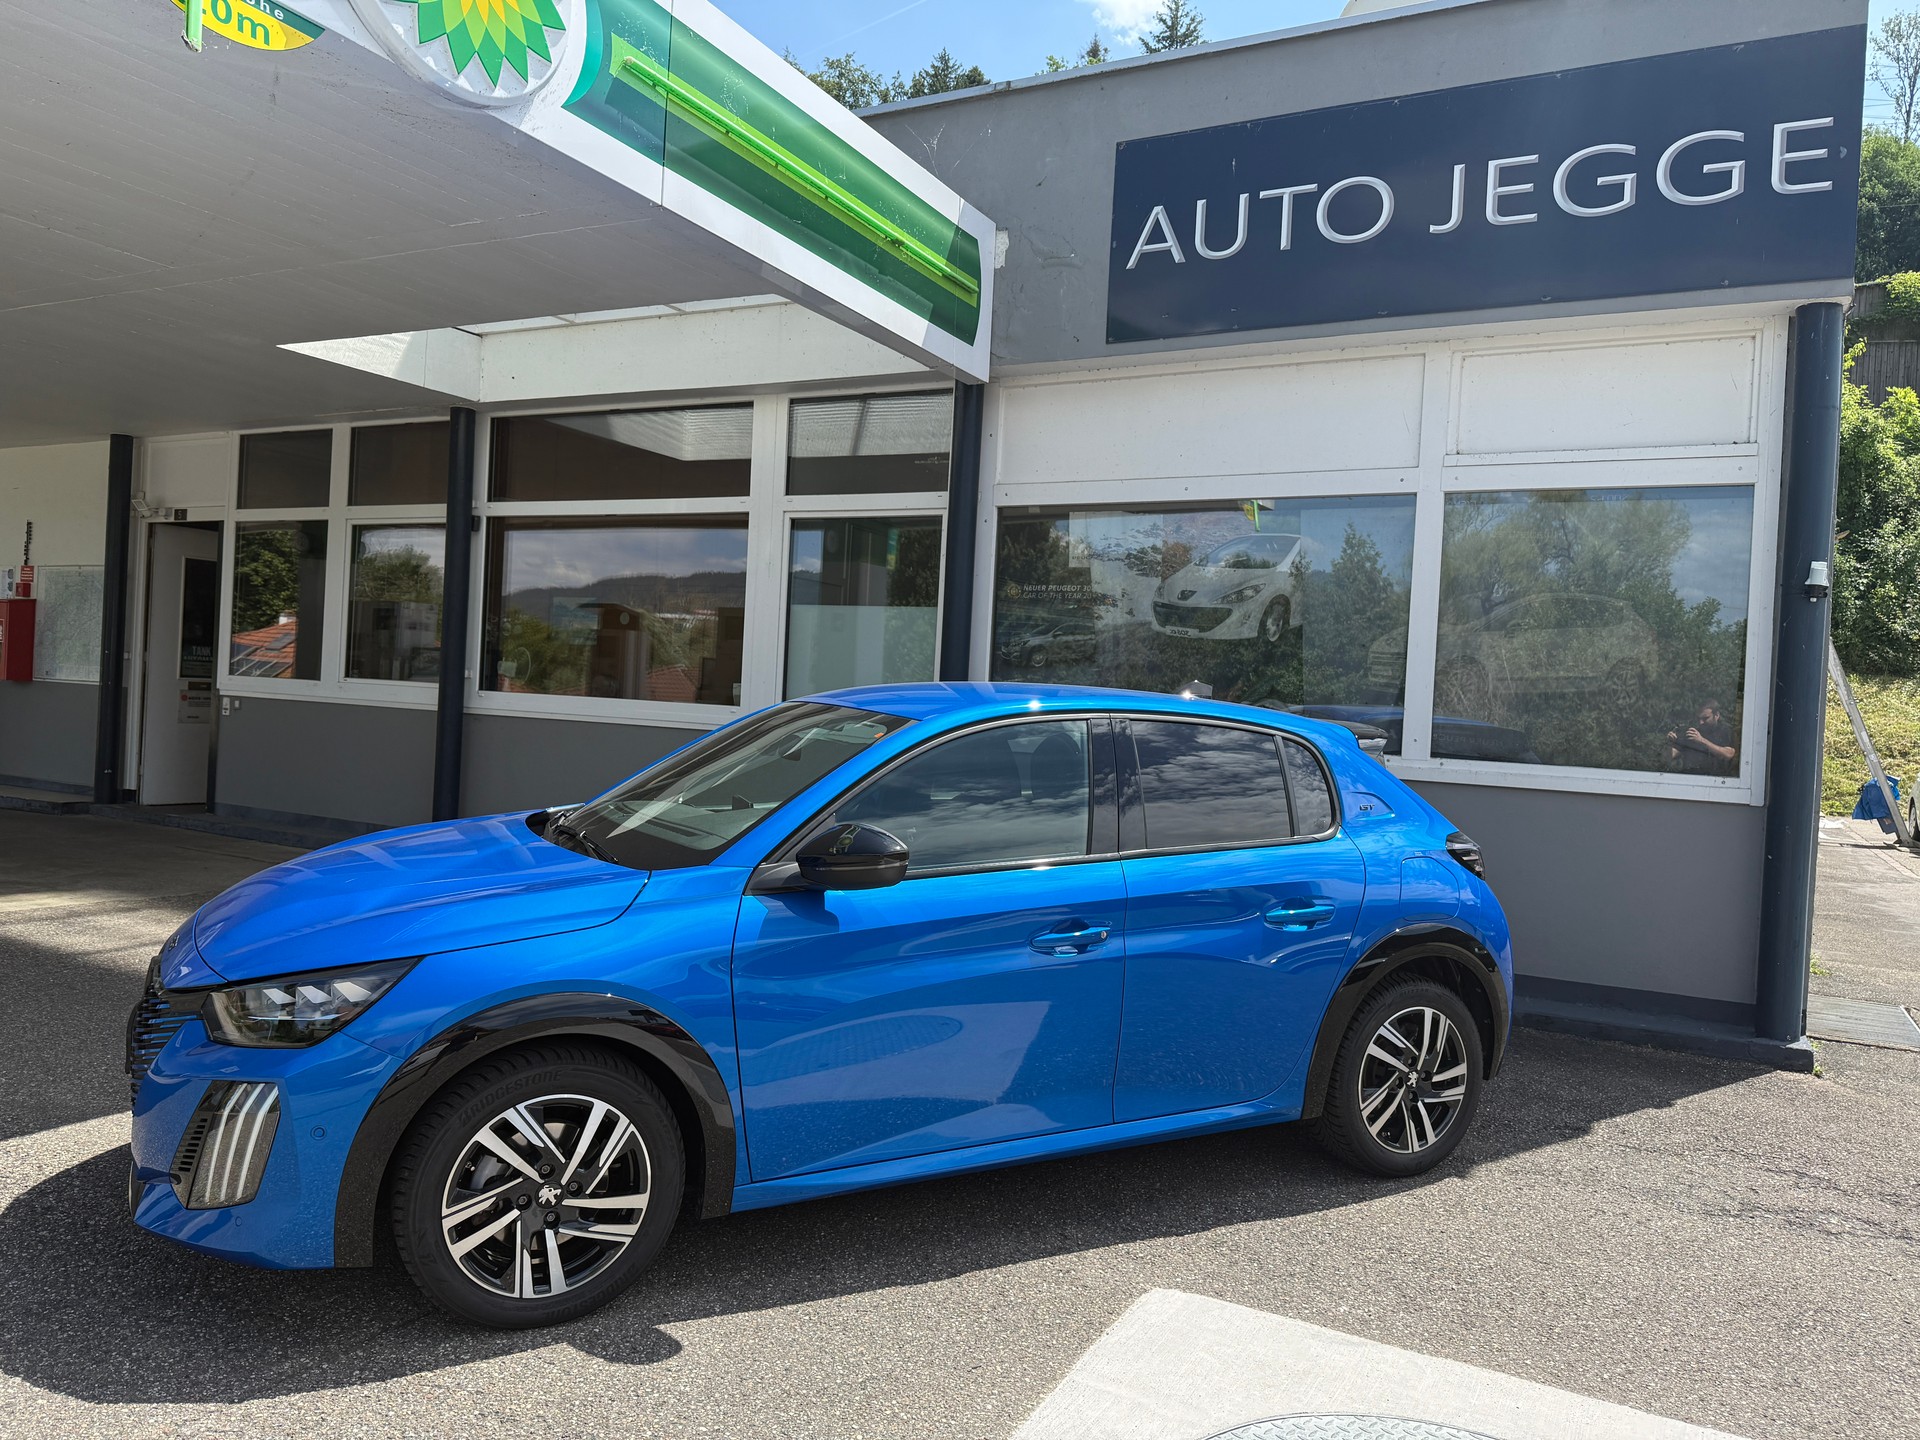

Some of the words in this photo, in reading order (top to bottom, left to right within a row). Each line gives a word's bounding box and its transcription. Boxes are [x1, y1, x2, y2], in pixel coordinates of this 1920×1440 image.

[1126, 175, 1395, 270] AUTO
[1429, 117, 1835, 234] JEGGE
[192, 645, 211, 656] TANK
[1359, 803, 1376, 811] GT
[457, 1069, 563, 1128] BRIDGESTONE
